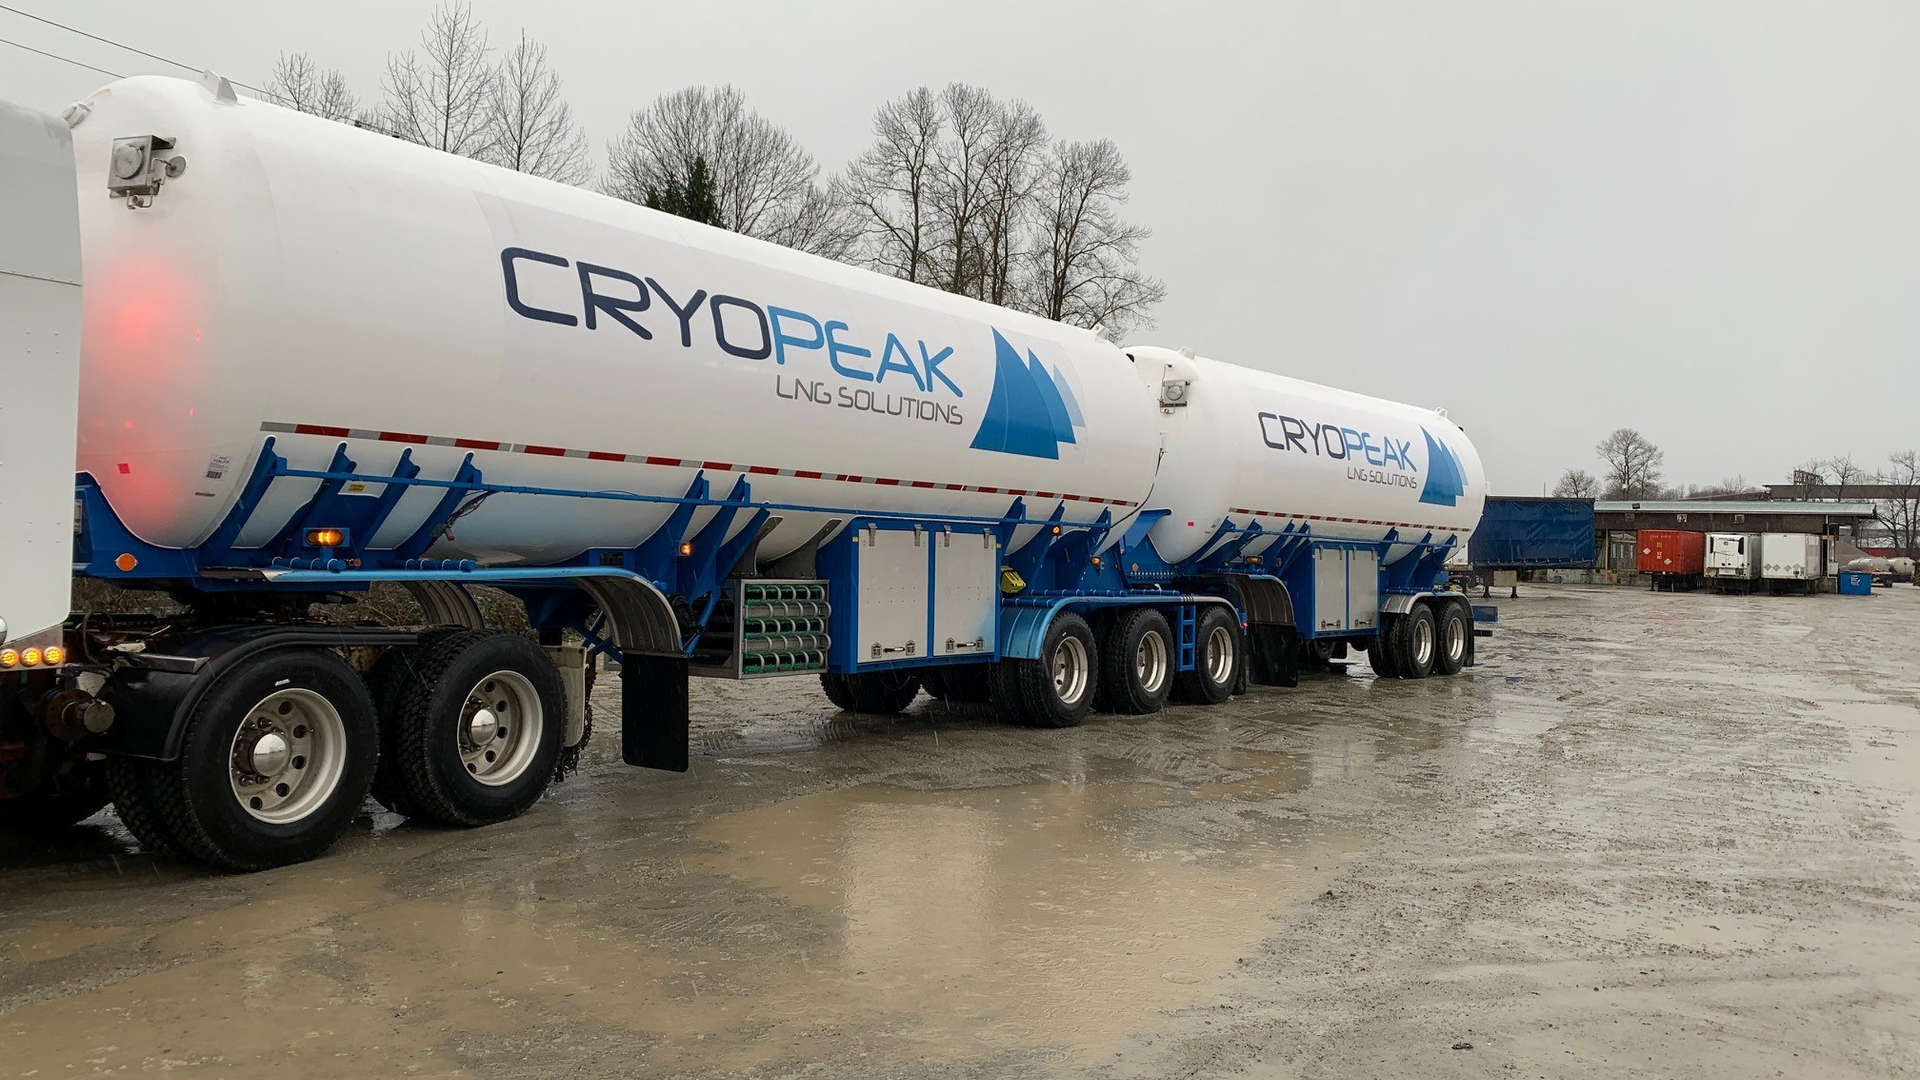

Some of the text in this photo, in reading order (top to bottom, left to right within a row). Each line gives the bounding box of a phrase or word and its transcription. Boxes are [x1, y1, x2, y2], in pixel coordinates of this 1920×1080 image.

[501, 247, 963, 397] CRYOPEAK
[776, 375, 964, 425] LNG SOLUTIONS
[1258, 412, 1418, 472] CRYOPEAK
[1347, 467, 1417, 489] LNG SOLUTIONS
